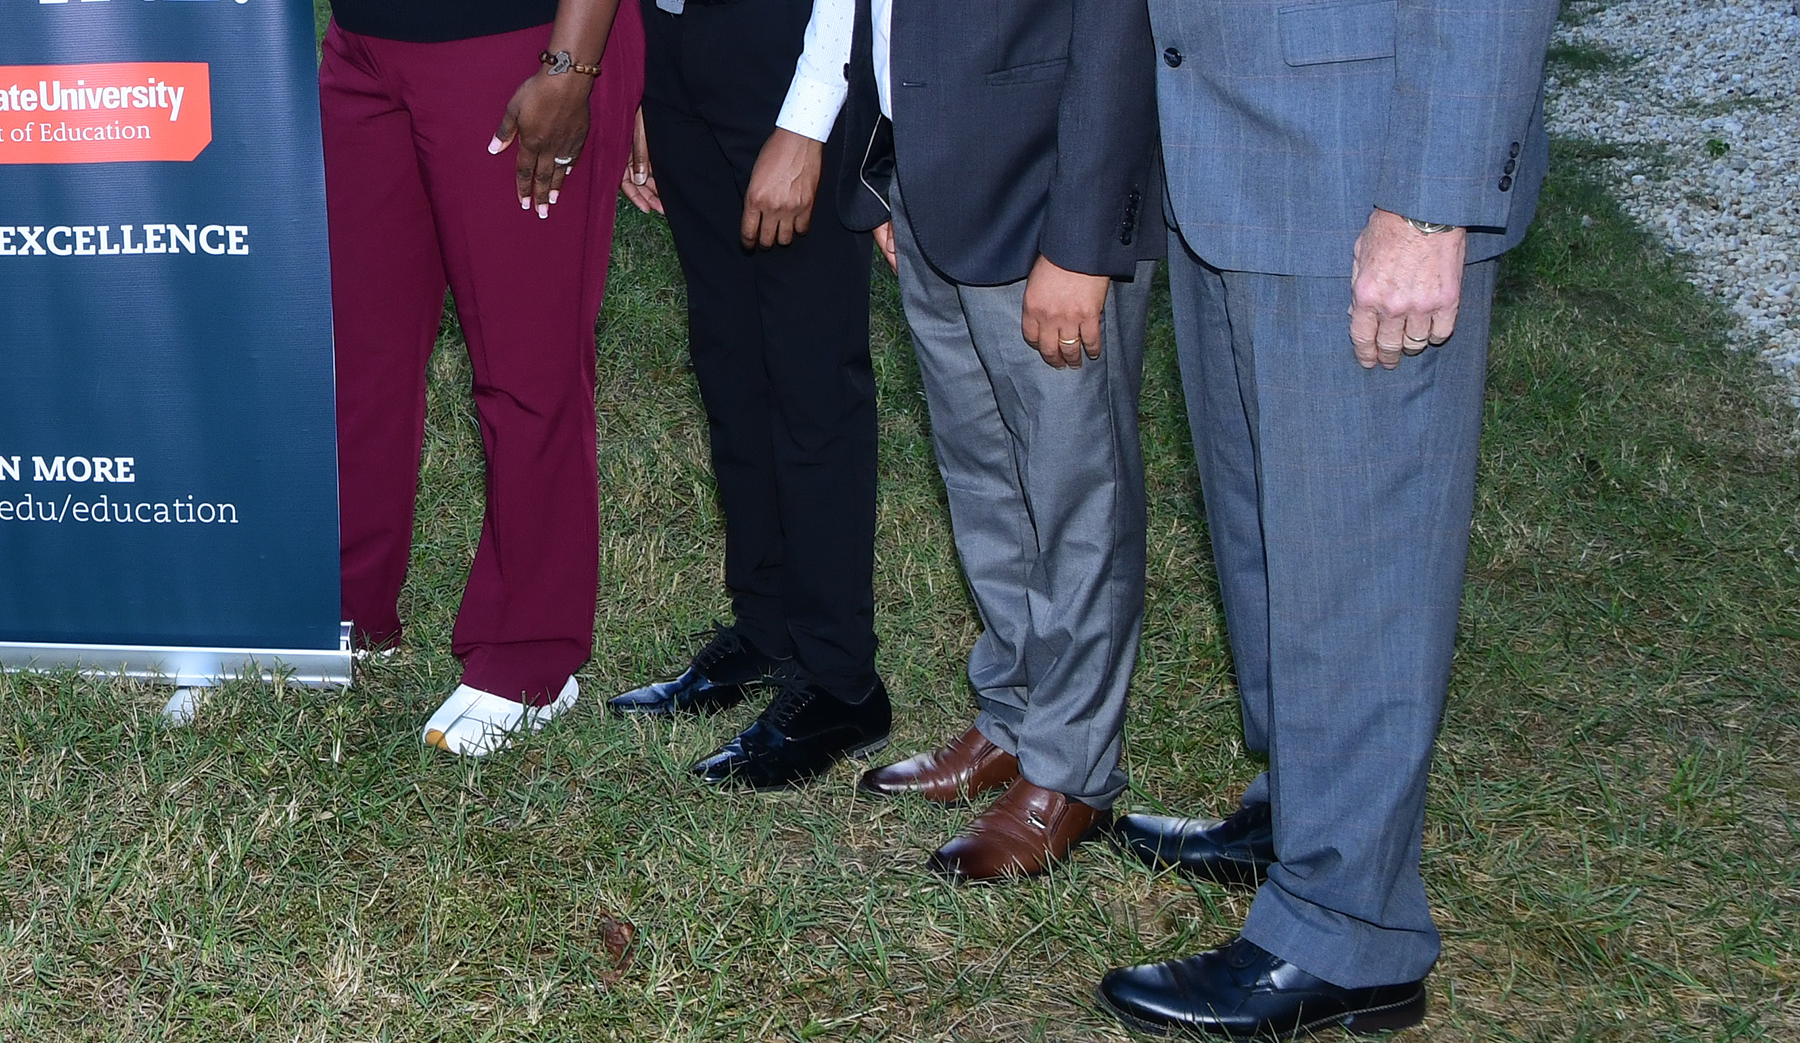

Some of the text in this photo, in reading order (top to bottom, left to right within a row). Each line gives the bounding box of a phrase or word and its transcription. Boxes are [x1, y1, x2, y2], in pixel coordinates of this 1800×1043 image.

[10, 122, 35, 142] of
[39, 121, 151, 142] Education
[31, 456, 135, 483] MORE
